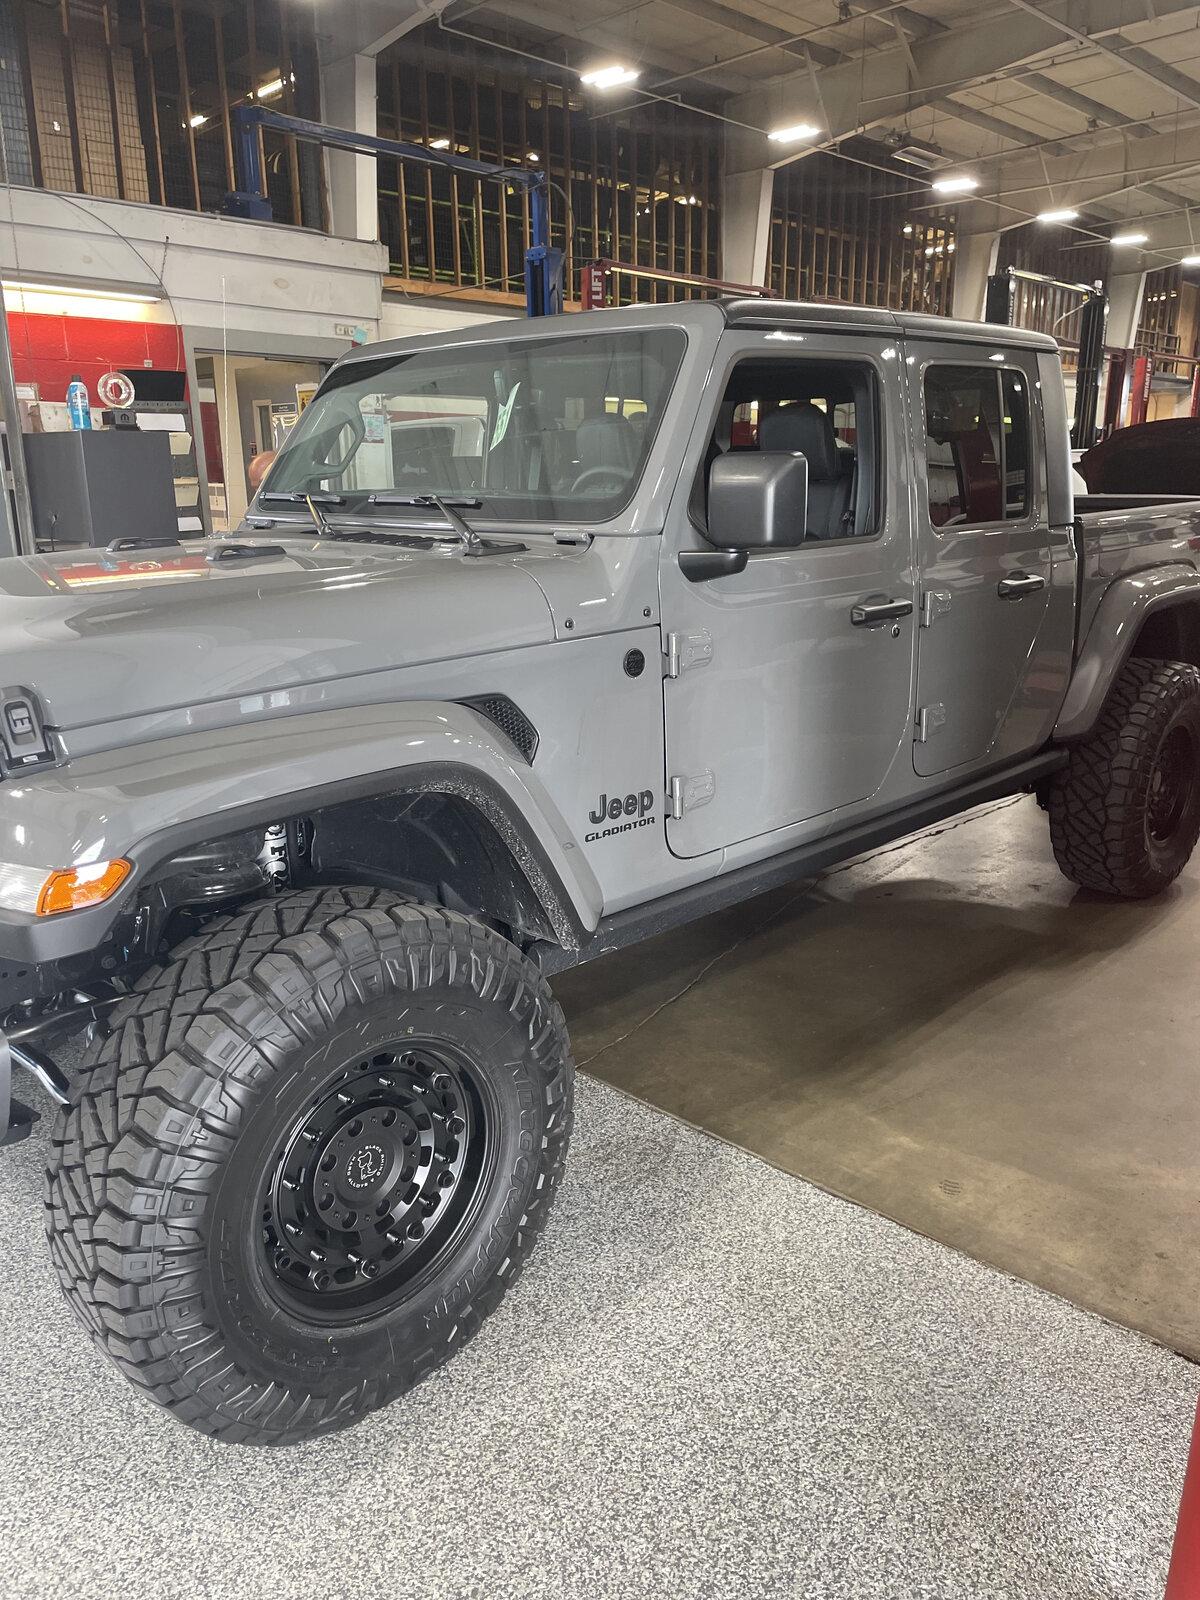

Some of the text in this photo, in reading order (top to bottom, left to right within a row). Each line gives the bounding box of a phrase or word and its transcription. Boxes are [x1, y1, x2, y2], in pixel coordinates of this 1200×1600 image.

[591, 268, 602, 300] LIFT
[588, 790, 654, 824] Jeep
[584, 816, 656, 843] GLADIATOR
[364, 1145, 382, 1153] BLACK
[348, 1178, 368, 1188] ALLOYS
